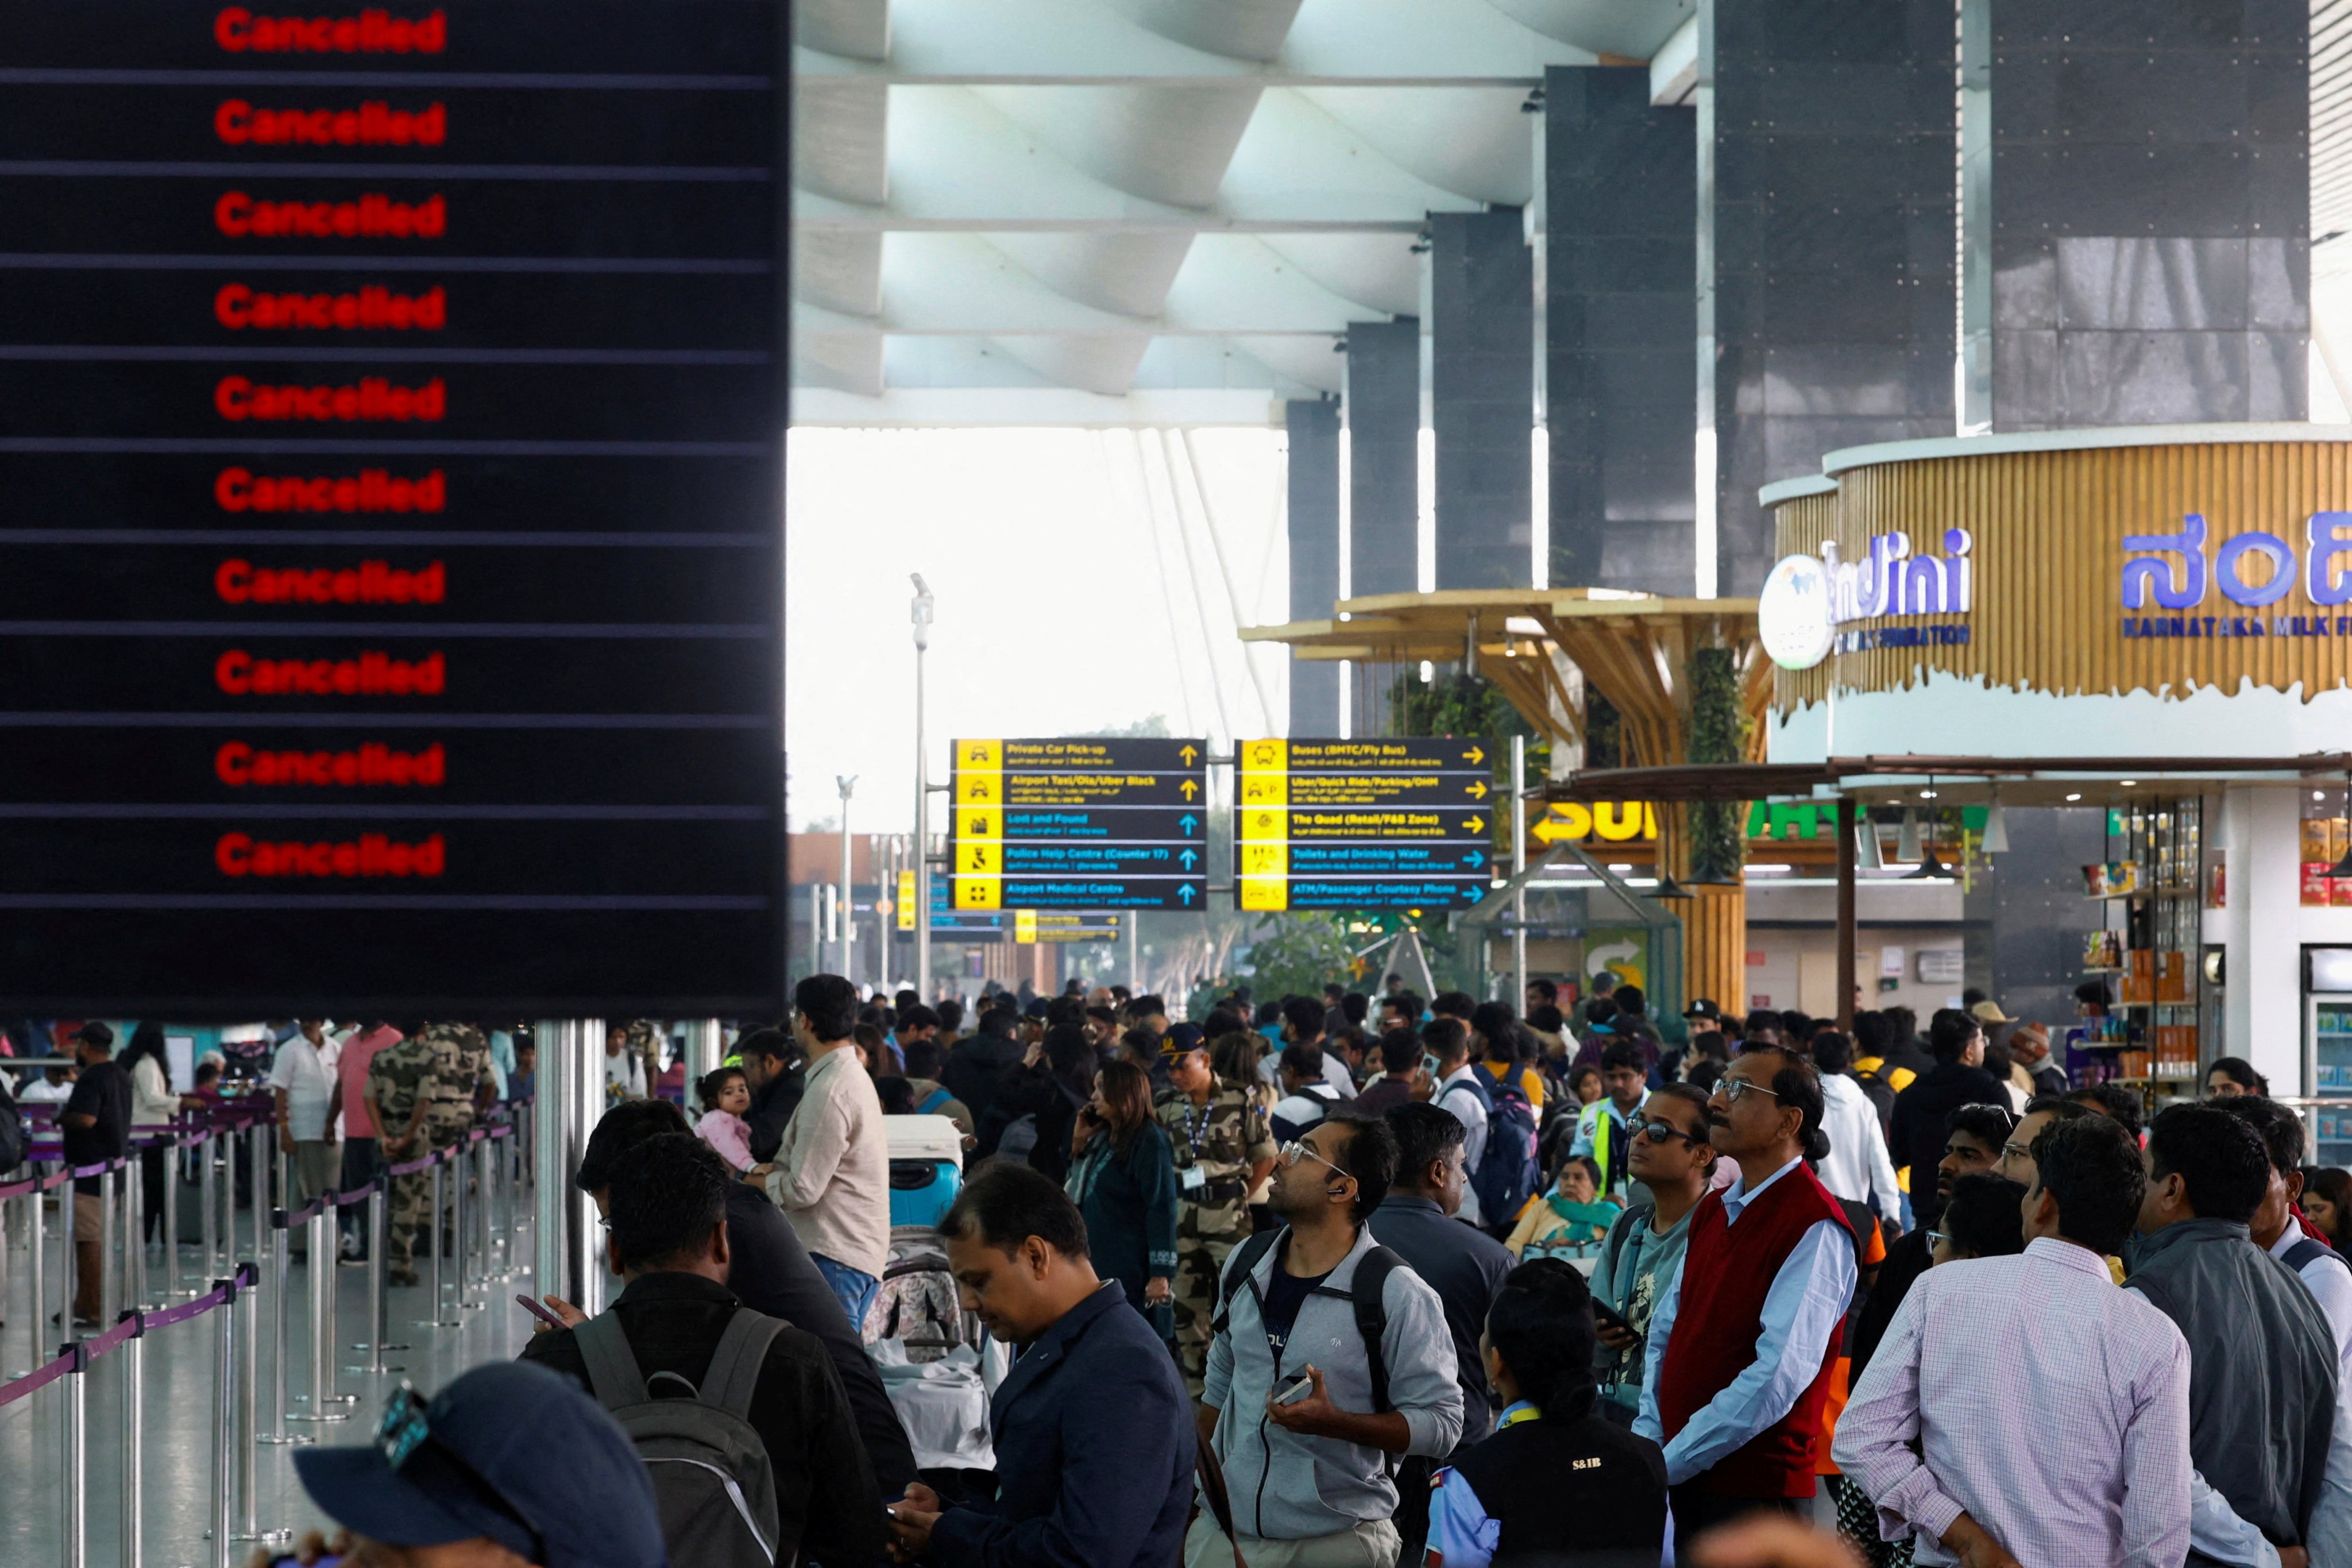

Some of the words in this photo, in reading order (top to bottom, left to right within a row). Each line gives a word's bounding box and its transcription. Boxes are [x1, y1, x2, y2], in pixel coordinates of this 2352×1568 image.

[215, 9, 445, 51] Cancelled
[215, 101, 445, 143] Cancelled
[215, 194, 445, 234] Cancelled
[215, 285, 445, 327] Cancelled
[215, 378, 445, 418] Cancelled
[215, 469, 445, 510] Cancelled
[215, 561, 445, 601] Cancelled
[2123, 616, 2265, 638] KARNATAKA
[2274, 616, 2329, 637] MILK
[216, 652, 444, 693] Cancelled
[1007, 744, 1044, 754] Private
[1045, 744, 1064, 754] Car
[1066, 744, 1106, 755] Pick-up
[1292, 745, 1322, 755] Buses
[1324, 745, 1380, 756] (BMTC/Fly
[1382, 745, 1407, 755] Bus)
[216, 744, 444, 783] Cancelled
[1011, 775, 1049, 786] Airport
[1051, 775, 1124, 786] Taxi/Ola/Uber
[1126, 775, 1156, 786] Black
[1292, 777, 1346, 787] Uber/Quick
[1007, 813, 1030, 824] Lost
[1032, 813, 1052, 824] and
[1054, 813, 1088, 824] Found
[1292, 814, 1312, 824] The
[1314, 814, 1343, 825] Quad
[1345, 814, 1406, 825] (Retail/F&B
[1408, 814, 1439, 825] Zone)
[216, 834, 444, 874] Cancelled
[1006, 848, 1038, 859] Police
[1040, 848, 1065, 860] Help
[1067, 848, 1103, 859] Centre
[1104, 848, 1151, 860] (Counter
[1152, 848, 1169, 860] 17)
[1292, 848, 1327, 859] Toilets
[1329, 848, 1349, 859] and
[1351, 848, 1396, 860] Drinking
[1397, 848, 1429, 859] Water
[1007, 883, 1044, 894] Airport
[1046, 883, 1087, 894] Medical
[1089, 883, 1125, 894] Centre
[1292, 883, 1373, 895] ATM/Passenger
[1423, 883, 1457, 894] Phone
[1573, 1457, 1601, 1470] S&IB
